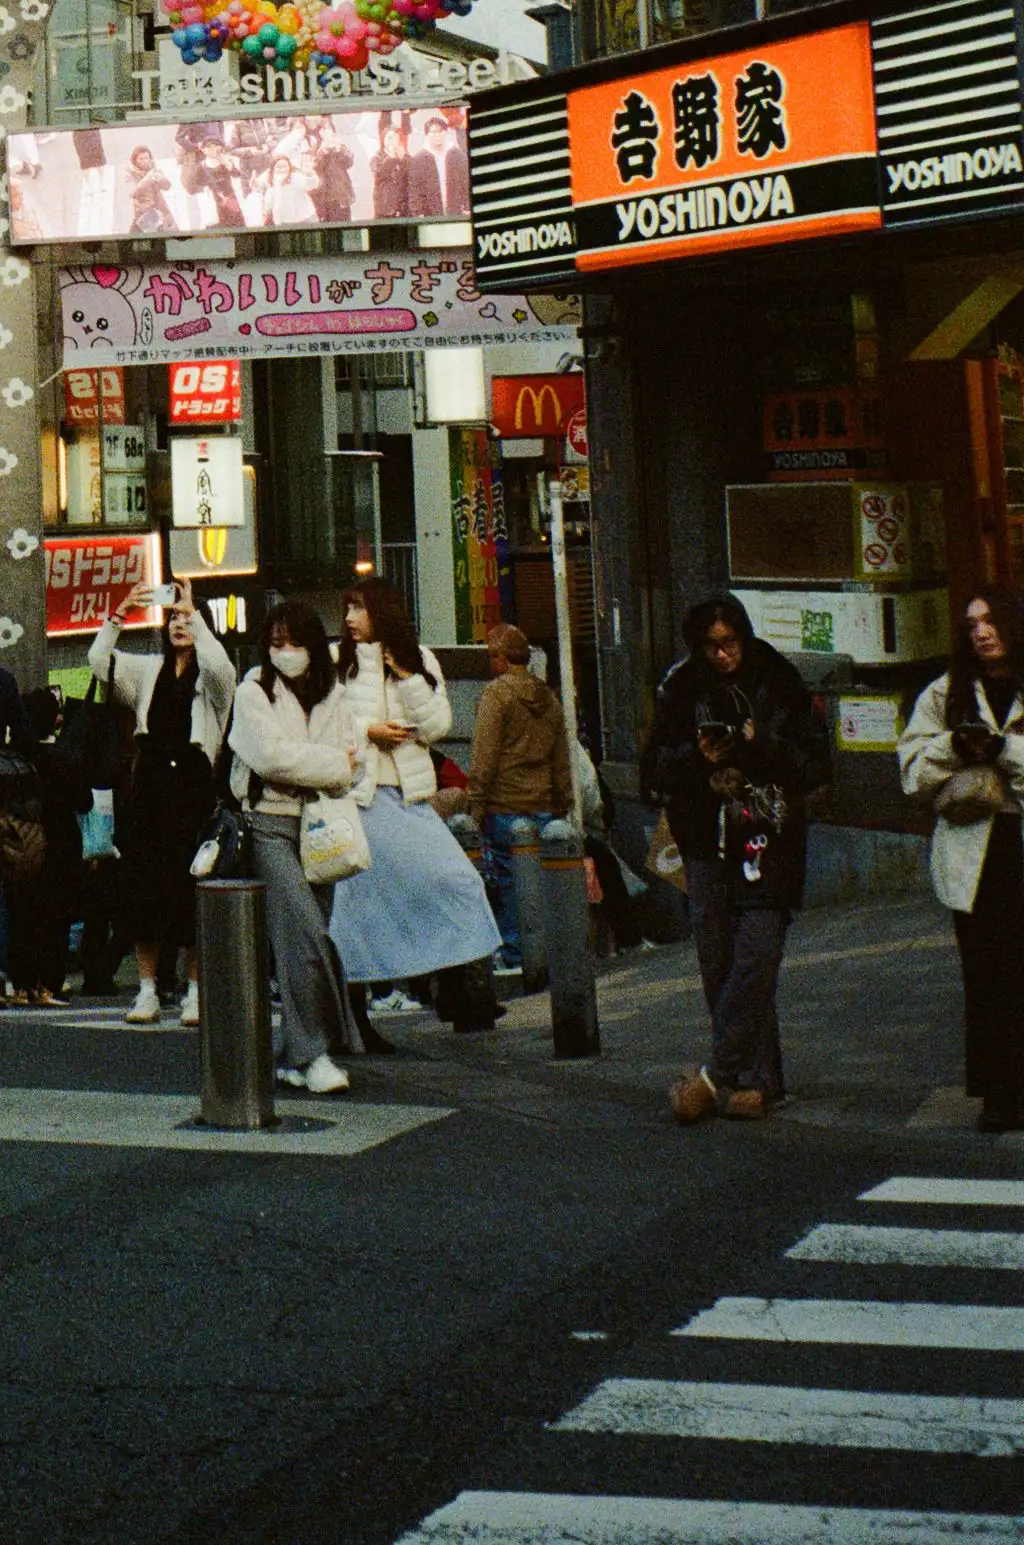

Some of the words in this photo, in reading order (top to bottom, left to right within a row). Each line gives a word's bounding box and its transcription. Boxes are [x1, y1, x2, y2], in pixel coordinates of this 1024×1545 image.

[131, 62, 352, 109] Takeshita
[611, 60, 789, 185] 吉野家
[887, 142, 1023, 194] YOSHINOYA
[615, 174, 795, 240] YOSHINOYA
[478, 220, 572, 258] YOSHINOYA
[173, 365, 227, 394] OS
[173, 399, 230, 416] ドラッグ
[46, 545, 147, 588] Sドラッグ
